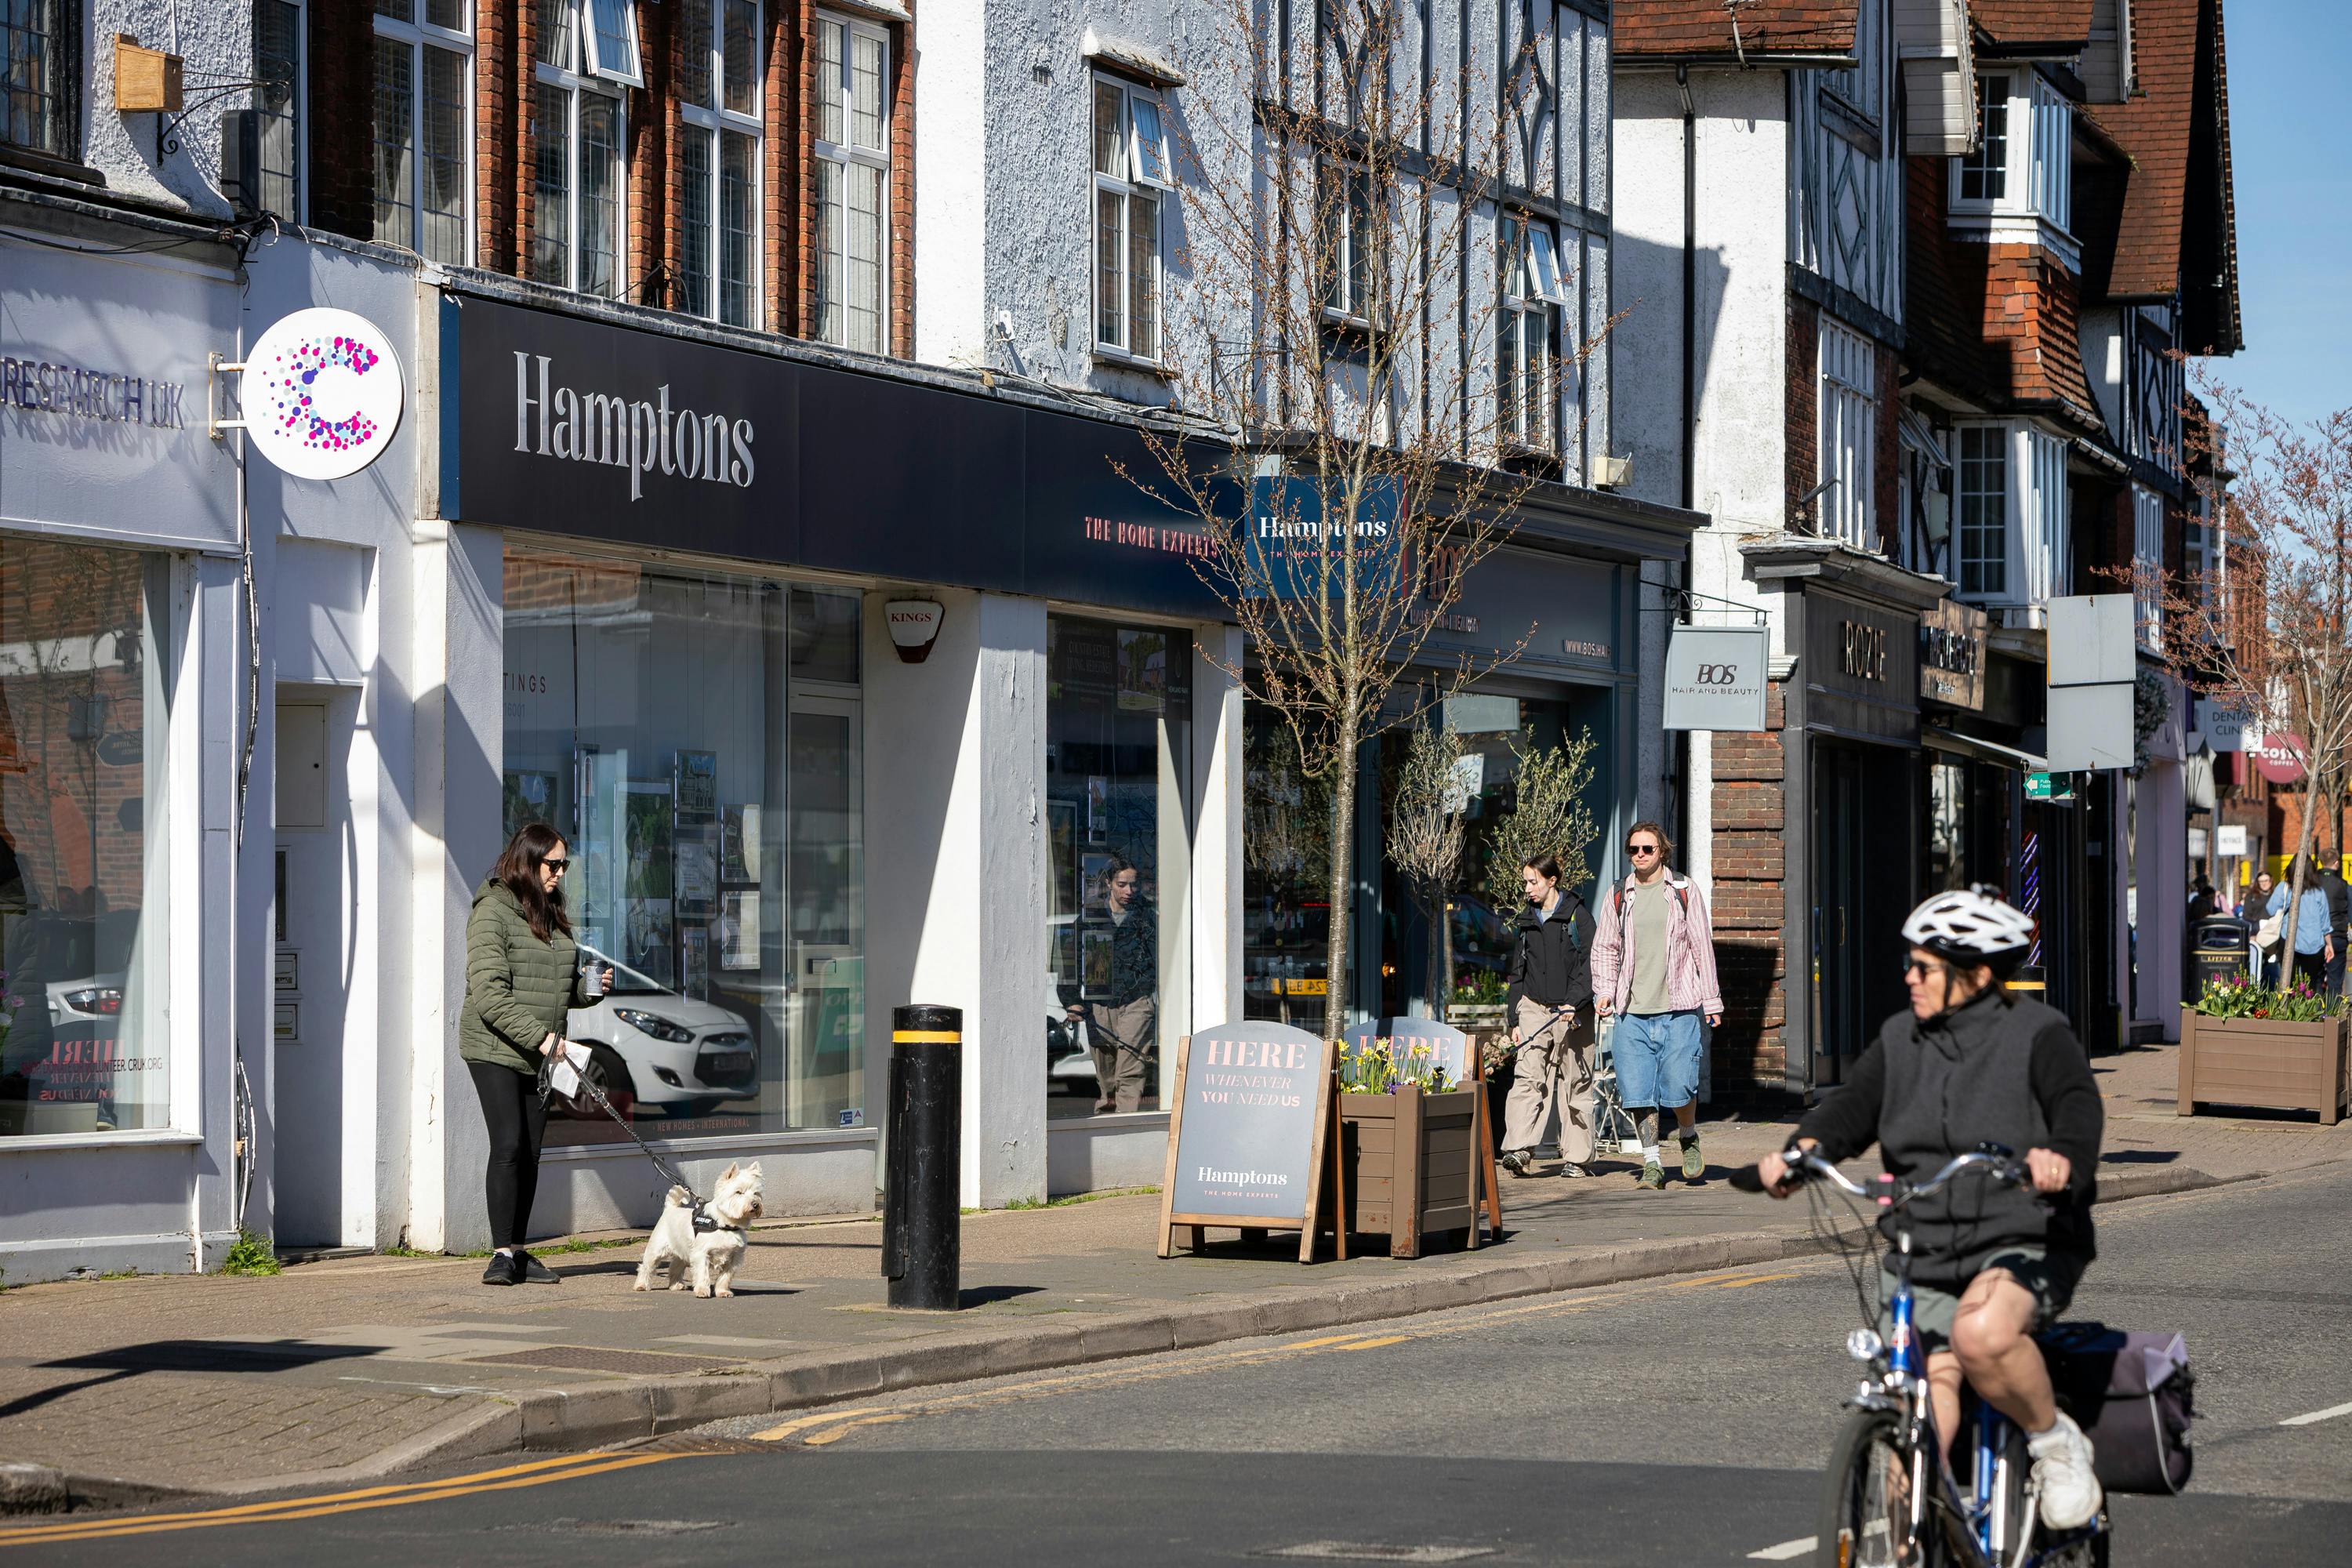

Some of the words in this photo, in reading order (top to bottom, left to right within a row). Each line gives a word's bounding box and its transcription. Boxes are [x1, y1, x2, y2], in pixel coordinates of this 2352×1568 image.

[4, 357, 142, 424] RESEARCH
[151, 379, 185, 430] UK
[514, 350, 754, 502] Hamptons
[1085, 516, 1111, 542] THE
[1118, 521, 1156, 549] HOME
[1162, 529, 1218, 558] EXPERTS
[891, 613, 931, 622] KINGS
[1695, 664, 1737, 684] BOS
[2212, 711, 2252, 722] DENTA
[2260, 747, 2304, 760] COSTA
[1206, 1040, 1306, 1069] HERE
[128, 1057, 162, 1072] CRUK.ORG
[1205, 1073, 1292, 1089] WHENEVER
[1201, 1091, 1233, 1104] YOU
[1236, 1091, 1279, 1105] NEED
[1281, 1095, 1301, 1107] US
[657, 1121, 671, 1132] NEW
[673, 1120, 695, 1131] HOMES
[702, 1118, 750, 1129] INTERNATIONAL
[1197, 1167, 1287, 1187] Hamptons
